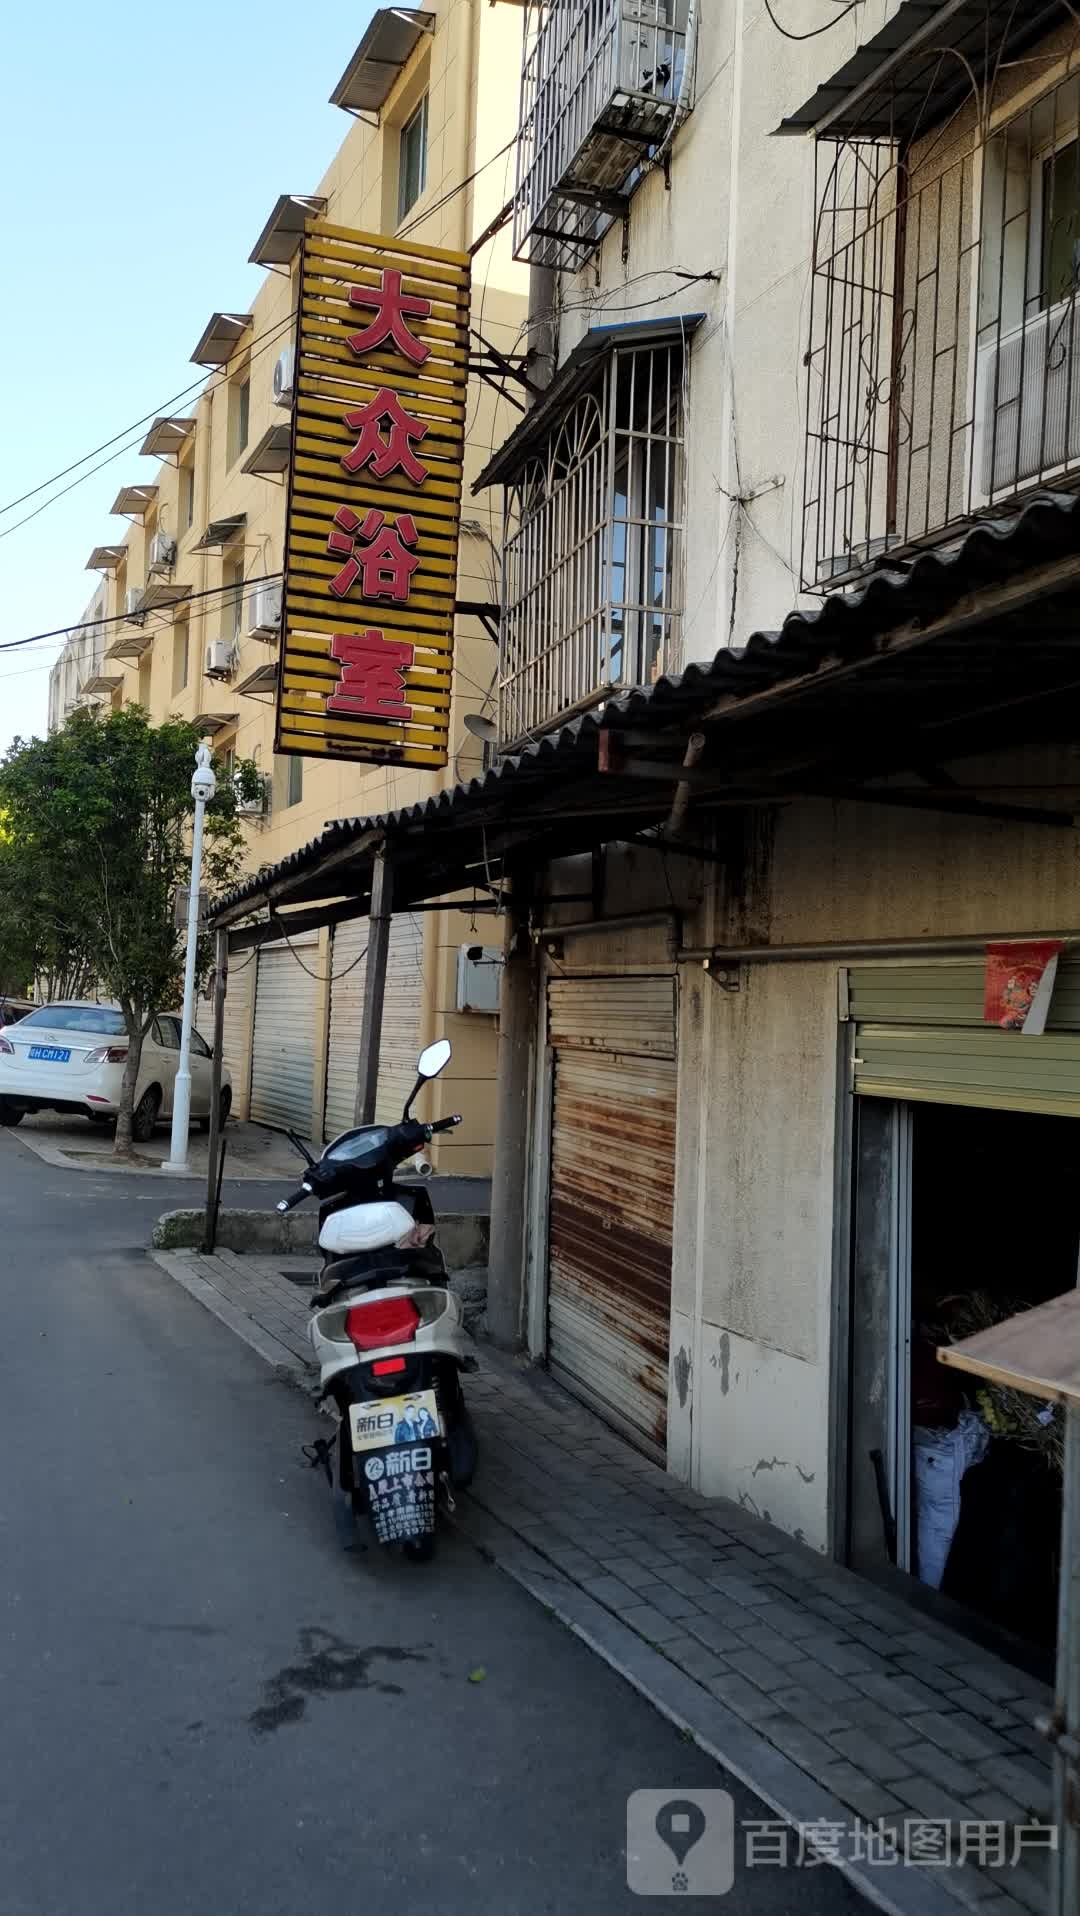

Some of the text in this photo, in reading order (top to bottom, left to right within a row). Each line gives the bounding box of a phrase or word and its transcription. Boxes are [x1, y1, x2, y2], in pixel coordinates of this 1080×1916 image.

[326, 268, 432, 720] 大众浴室
[356, 1412, 394, 1432] 新日
[386, 1447, 432, 1477] 新日
